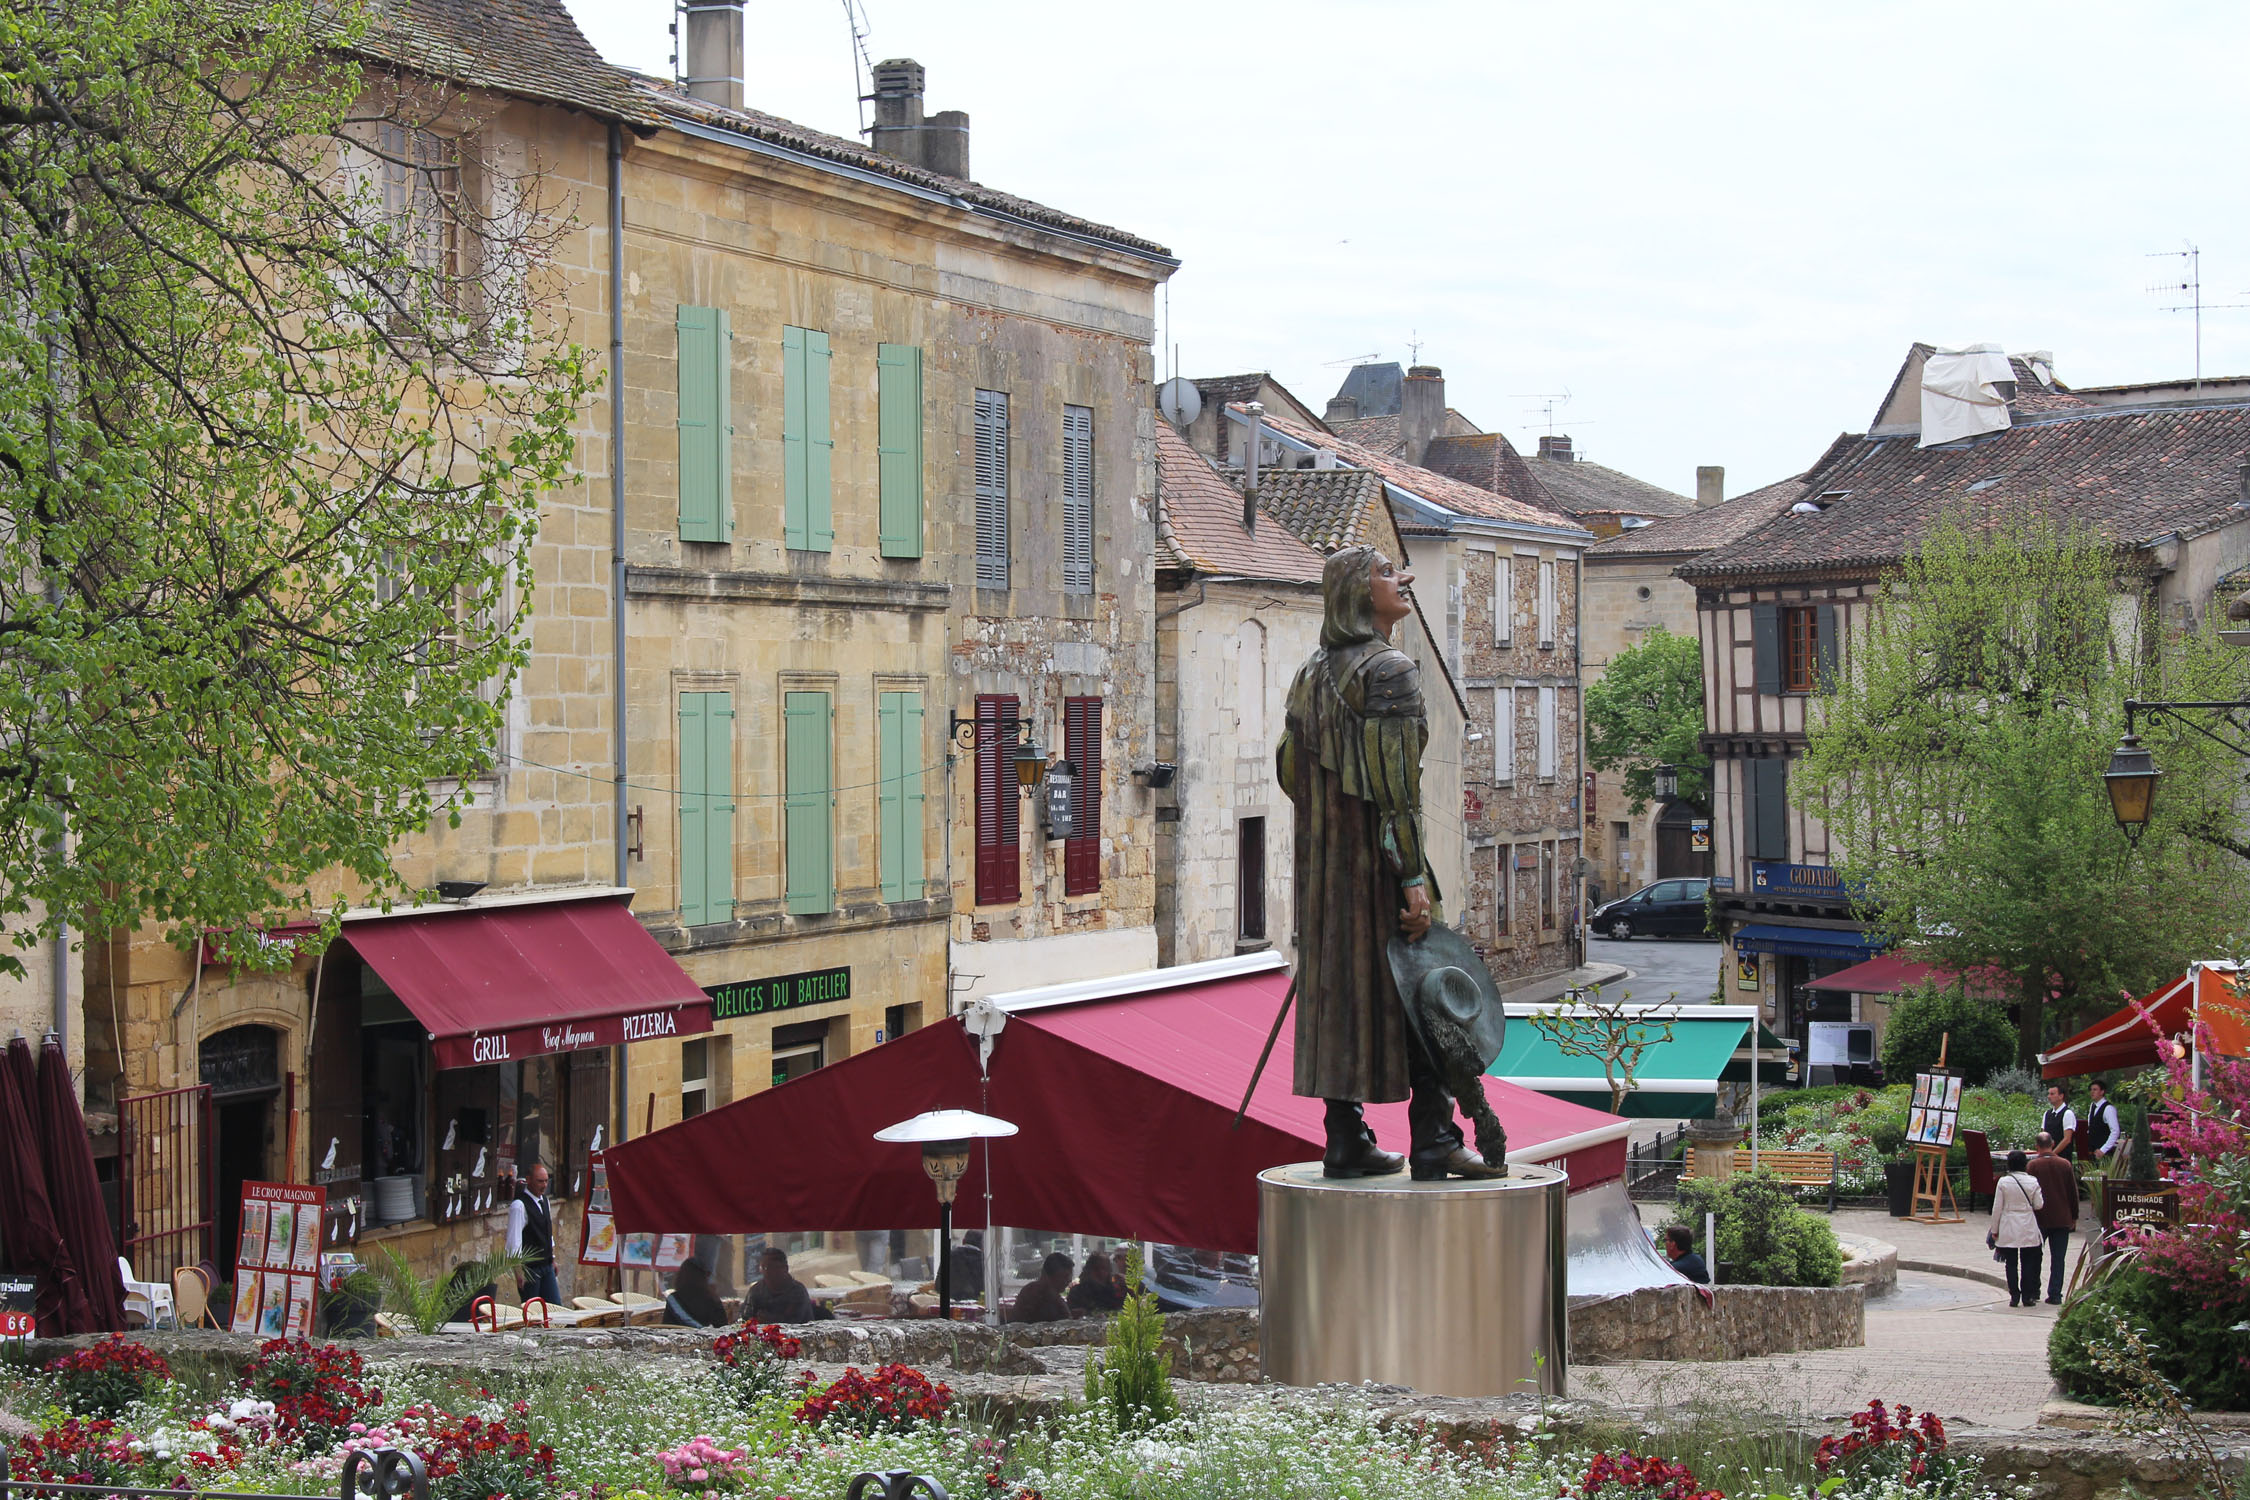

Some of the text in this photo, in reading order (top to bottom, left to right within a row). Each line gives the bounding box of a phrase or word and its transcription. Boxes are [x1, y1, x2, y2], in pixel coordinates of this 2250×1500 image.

[1053, 789, 1067, 799] BAR
[1789, 867, 1841, 888] GODARD
[716, 972, 847, 1017] DÉLICES DU BATELIER
[473, 1035, 510, 1063] GRILL
[561, 1023, 596, 1050] Magnon
[623, 1011, 677, 1041] PIZZERIA
[252, 1186, 261, 1197] LE
[283, 1189, 316, 1202] MAGNON
[2117, 1194, 2164, 1204] LA DÉSIRADE
[0, 1279, 34, 1292] nsieur
[8, 1316, 16, 1331] 6
